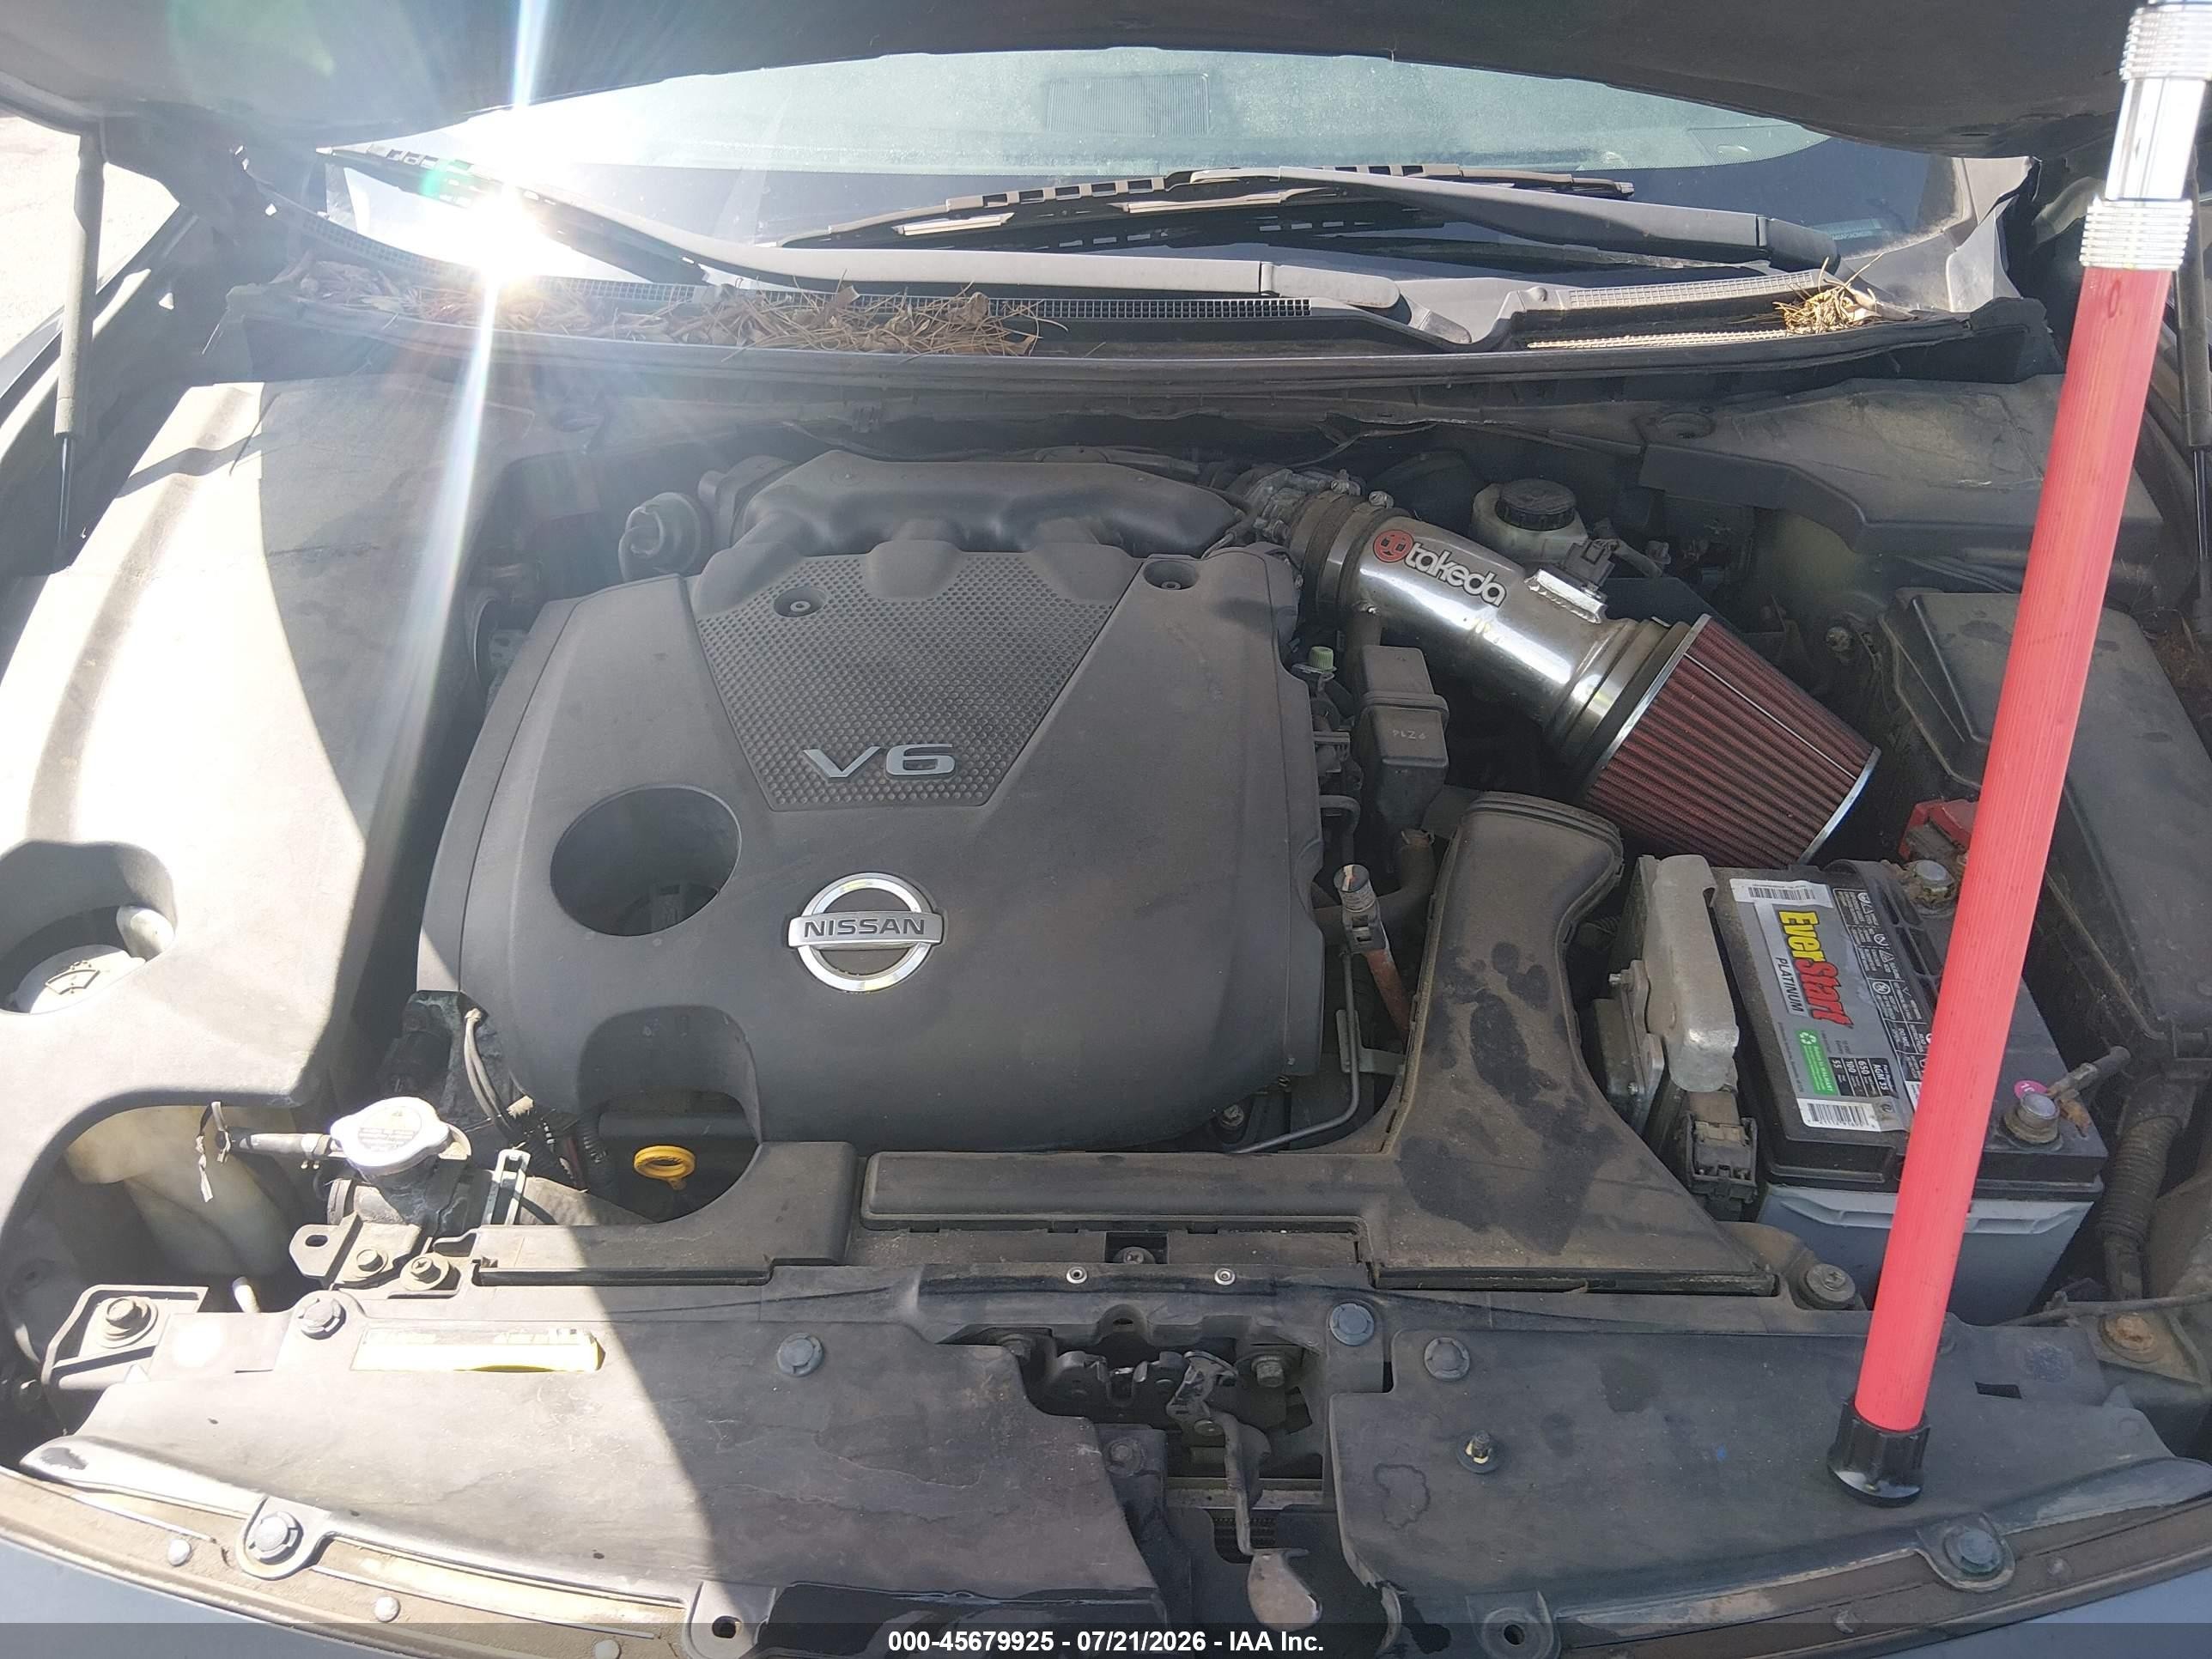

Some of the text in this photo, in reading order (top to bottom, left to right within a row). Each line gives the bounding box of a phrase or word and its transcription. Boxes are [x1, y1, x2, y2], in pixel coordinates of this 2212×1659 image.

[1405, 542, 1507, 607] takeda
[804, 744, 956, 778] V6
[804, 918, 925, 938] NISSAN
[1778, 910, 1855, 1026] EverStart
[1776, 957, 1804, 1012] PLATINUM
[1831, 1059, 1843, 1068] 55
[1844, 1060, 1857, 1073] 100
[1856, 1060, 1871, 1074] 650
[1871, 1063, 1889, 1090] AGM 35
